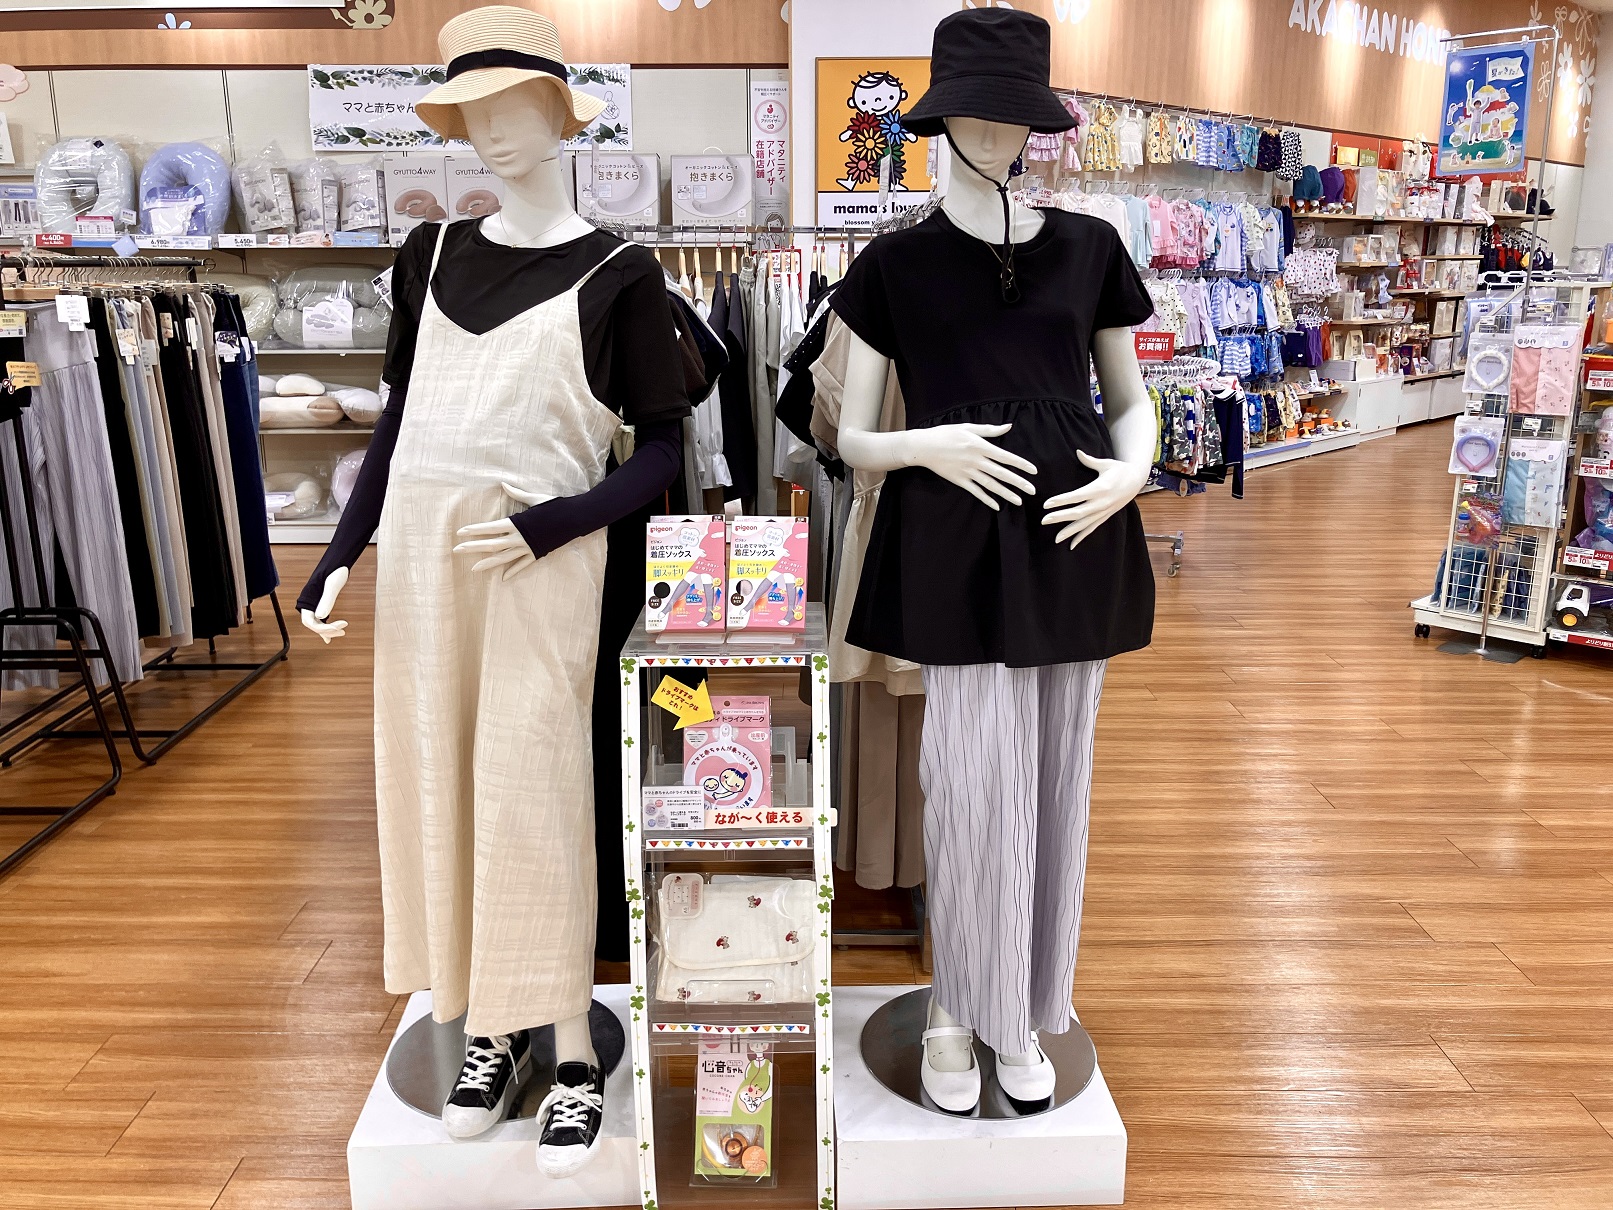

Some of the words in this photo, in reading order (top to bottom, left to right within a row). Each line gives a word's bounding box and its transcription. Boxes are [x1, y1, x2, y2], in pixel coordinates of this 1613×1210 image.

[343, 102, 415, 113] ママと赤ちゃん
[777, 140, 786, 182] マタニティ
[766, 140, 776, 195] アドバイザー
[690, 172, 734, 182] 抱きまくら
[1138, 343, 1168, 351] お買得!!
[650, 525, 673, 533] pigeon
[735, 524, 758, 532] pigeon
[734, 549, 776, 557] 着圧ソックス
[660, 687, 699, 711] ドライブマークは
[673, 686, 694, 701] おすすめ
[702, 1060, 743, 1073] 心音ちゃん
